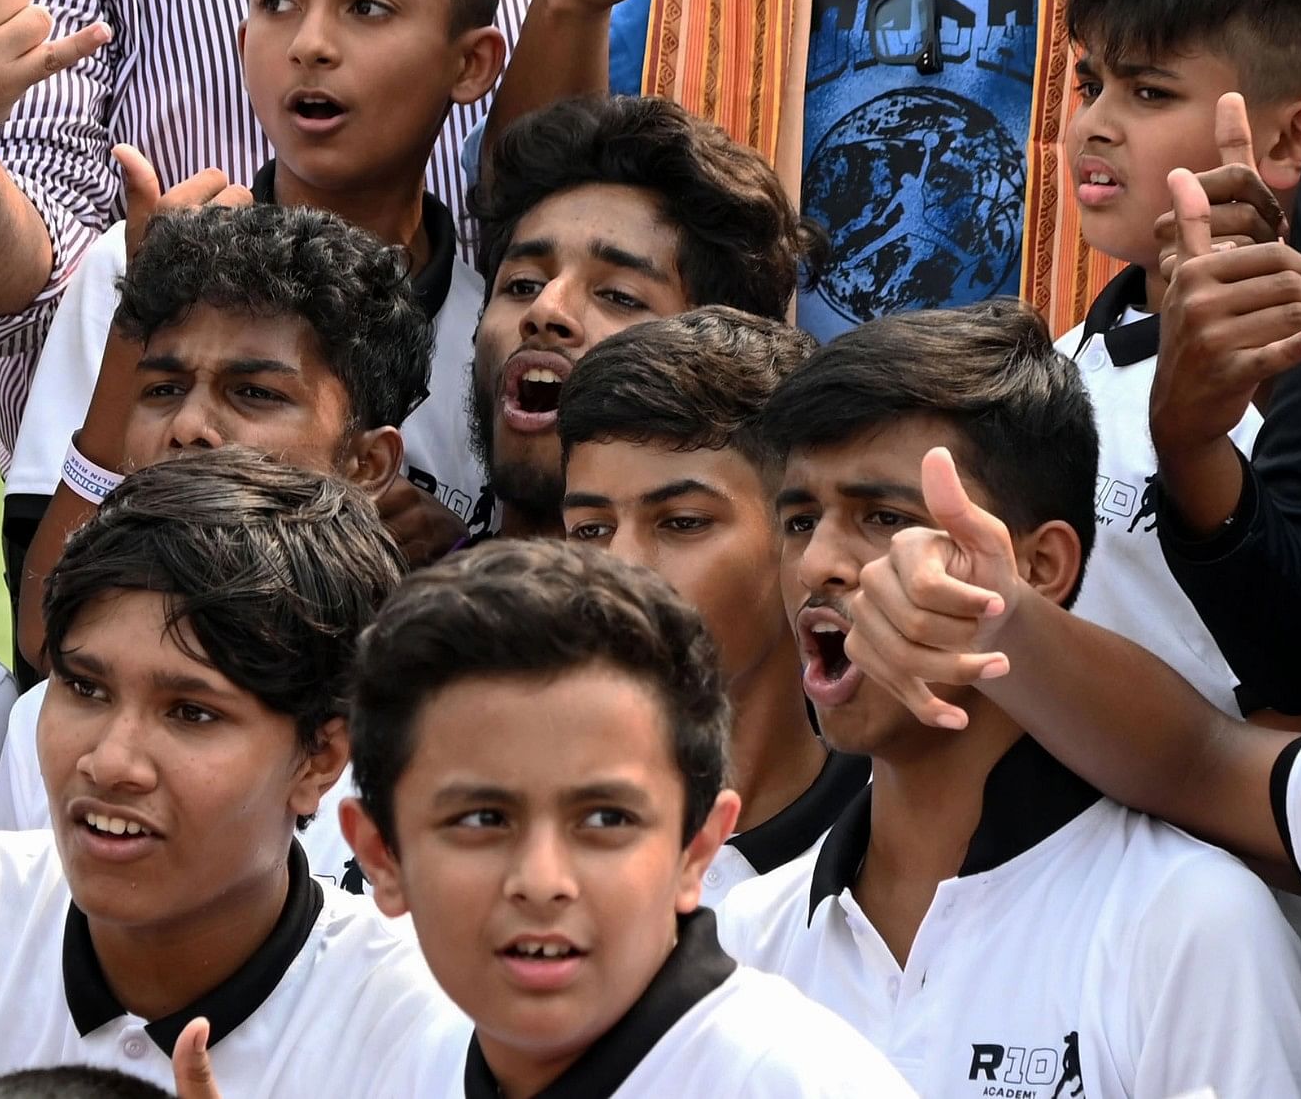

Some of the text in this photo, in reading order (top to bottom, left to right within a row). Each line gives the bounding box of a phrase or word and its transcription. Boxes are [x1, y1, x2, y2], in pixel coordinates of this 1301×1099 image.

[64, 461, 109, 497] LDINHO
[89, 472, 117, 487] RLIN
[968, 1043, 1059, 1085] R10
[982, 1086, 1038, 1099] ACADEMY
